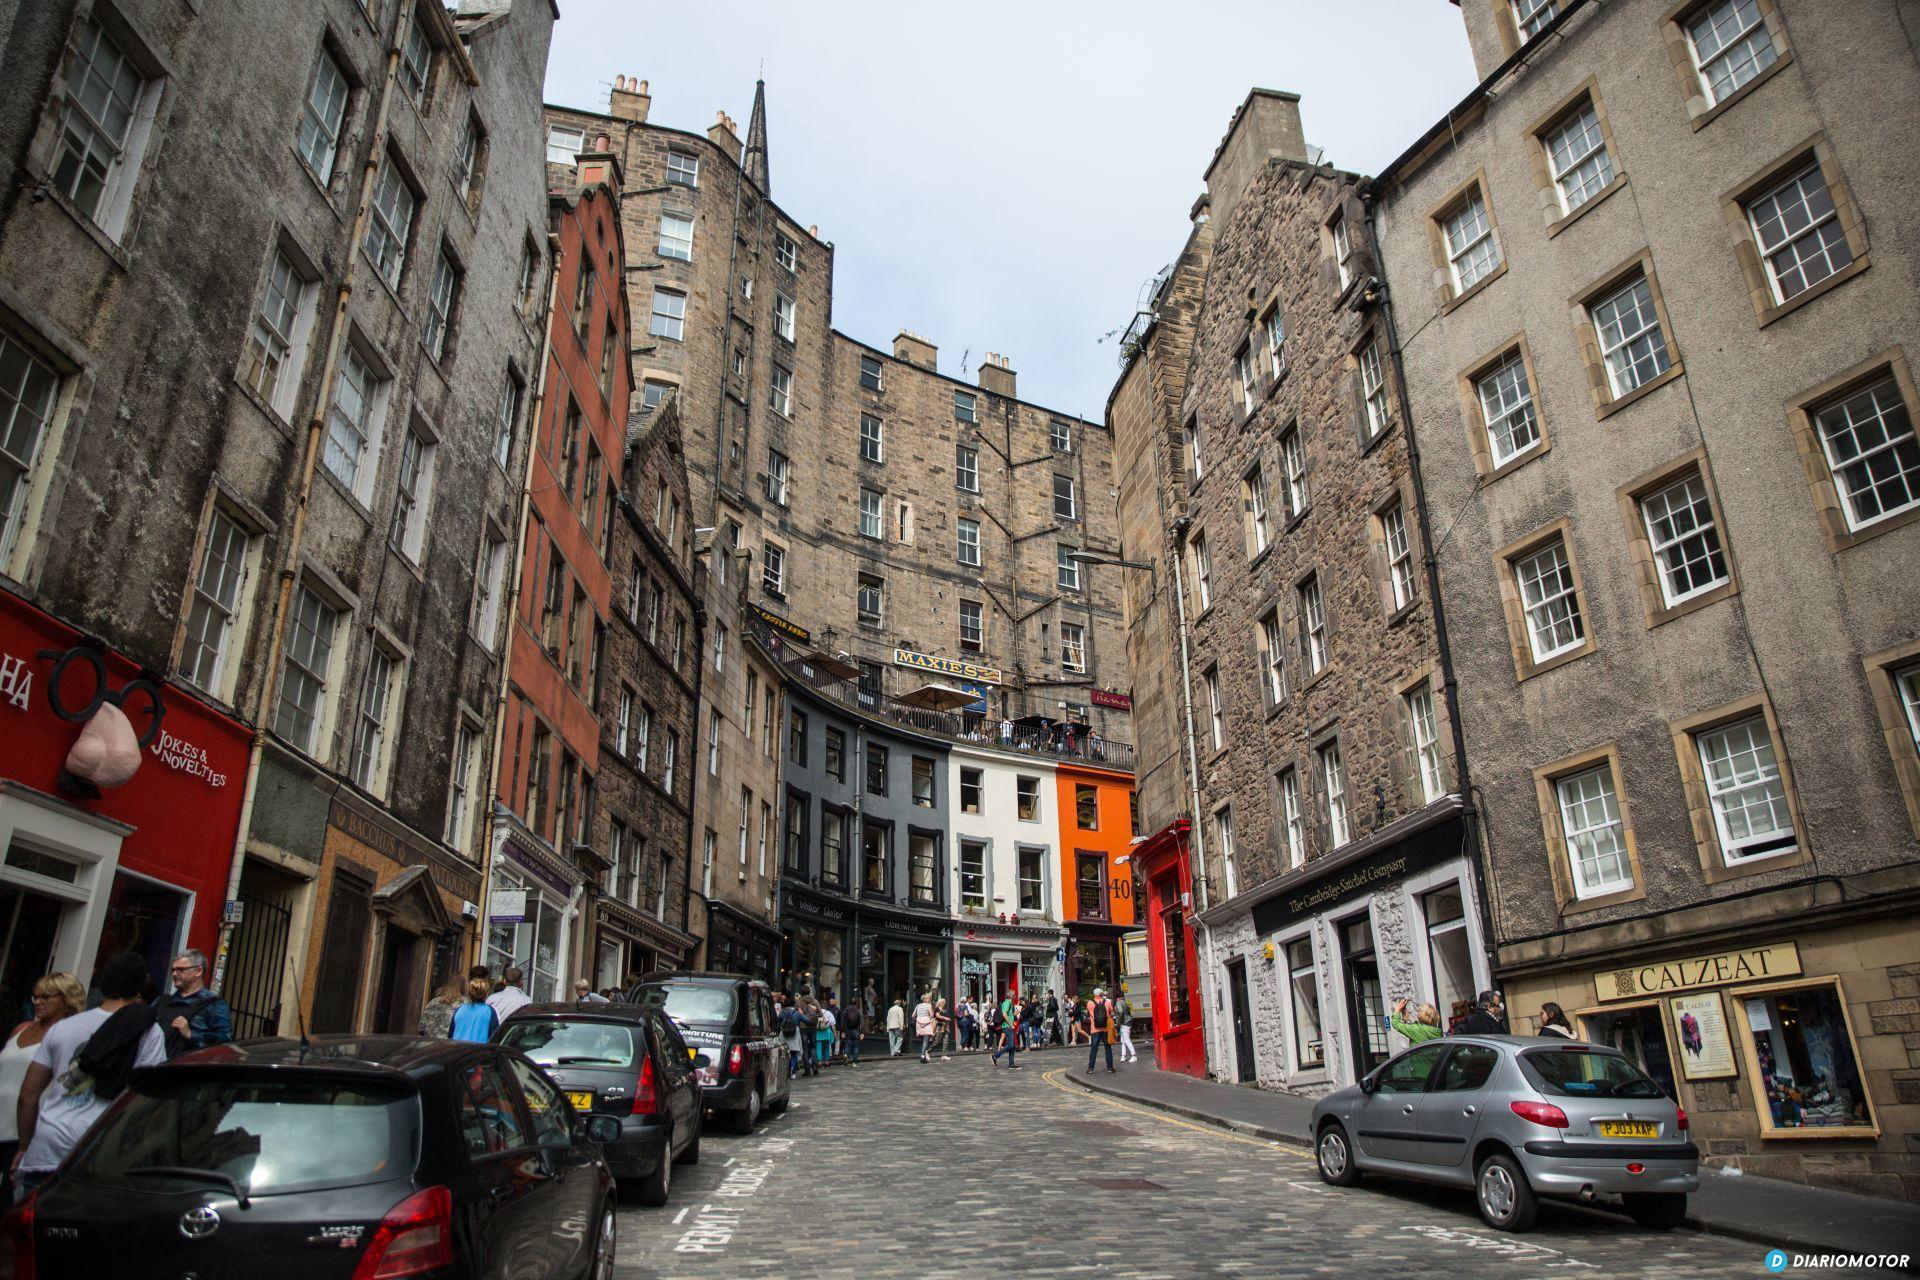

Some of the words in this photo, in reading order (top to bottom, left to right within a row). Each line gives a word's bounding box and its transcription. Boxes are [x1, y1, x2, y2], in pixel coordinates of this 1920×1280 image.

[899, 652, 977, 677] MAXIES
[151, 730, 198, 759] JOKES
[199, 750, 207, 764] &
[161, 751, 227, 788] NOVELTIES
[349, 814, 396, 854] BACCHUS
[1110, 878, 1130, 900] 40
[1289, 900, 1303, 912] The
[1303, 885, 1340, 907] Cambridge
[1340, 871, 1367, 893] Satchel
[1368, 858, 1406, 880] Company
[823, 907, 843, 920] Slater
[885, 921, 919, 933] LADIESWEAR
[1640, 949, 1772, 992] CALZEAT
[1605, 1122, 1633, 1135] PJ03
[1634, 1122, 1652, 1135] XAP
